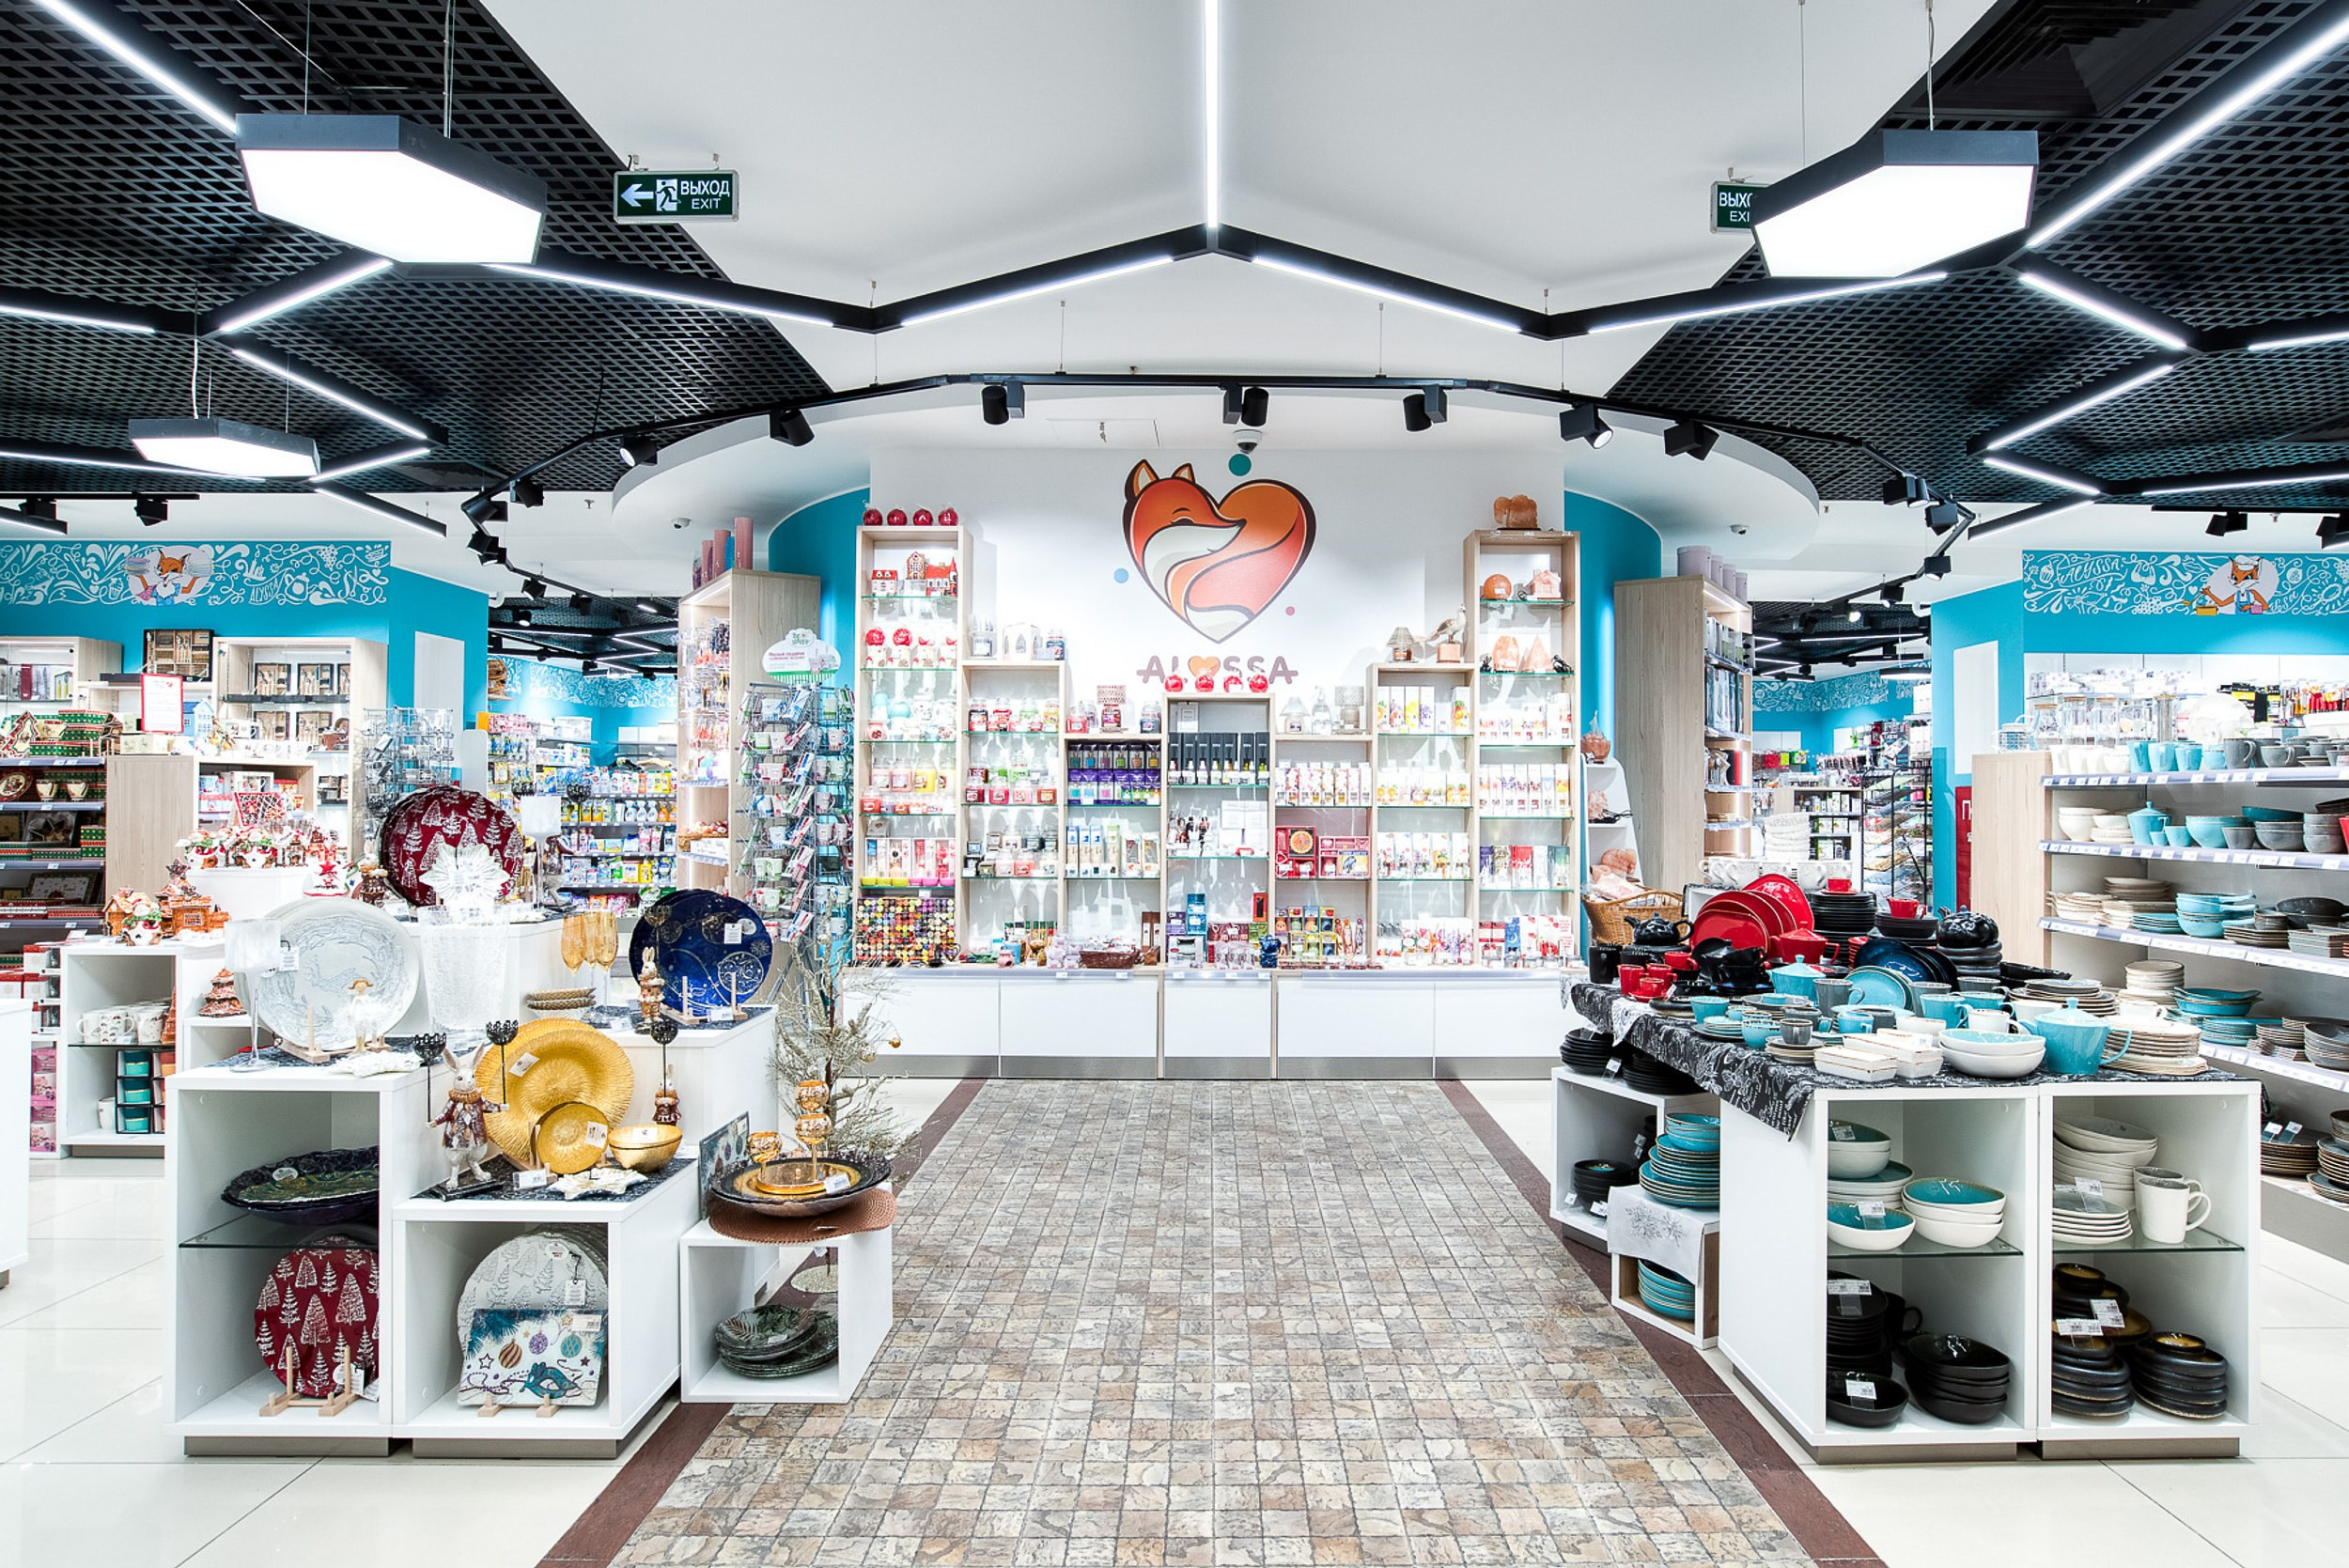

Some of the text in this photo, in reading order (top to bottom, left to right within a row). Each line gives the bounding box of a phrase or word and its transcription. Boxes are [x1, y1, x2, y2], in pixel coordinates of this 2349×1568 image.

[680, 180, 730, 197] ВЫХОД
[692, 197, 721, 210] EXIT
[1719, 192, 1753, 208] ВЫХ
[1730, 210, 1750, 223] EXI
